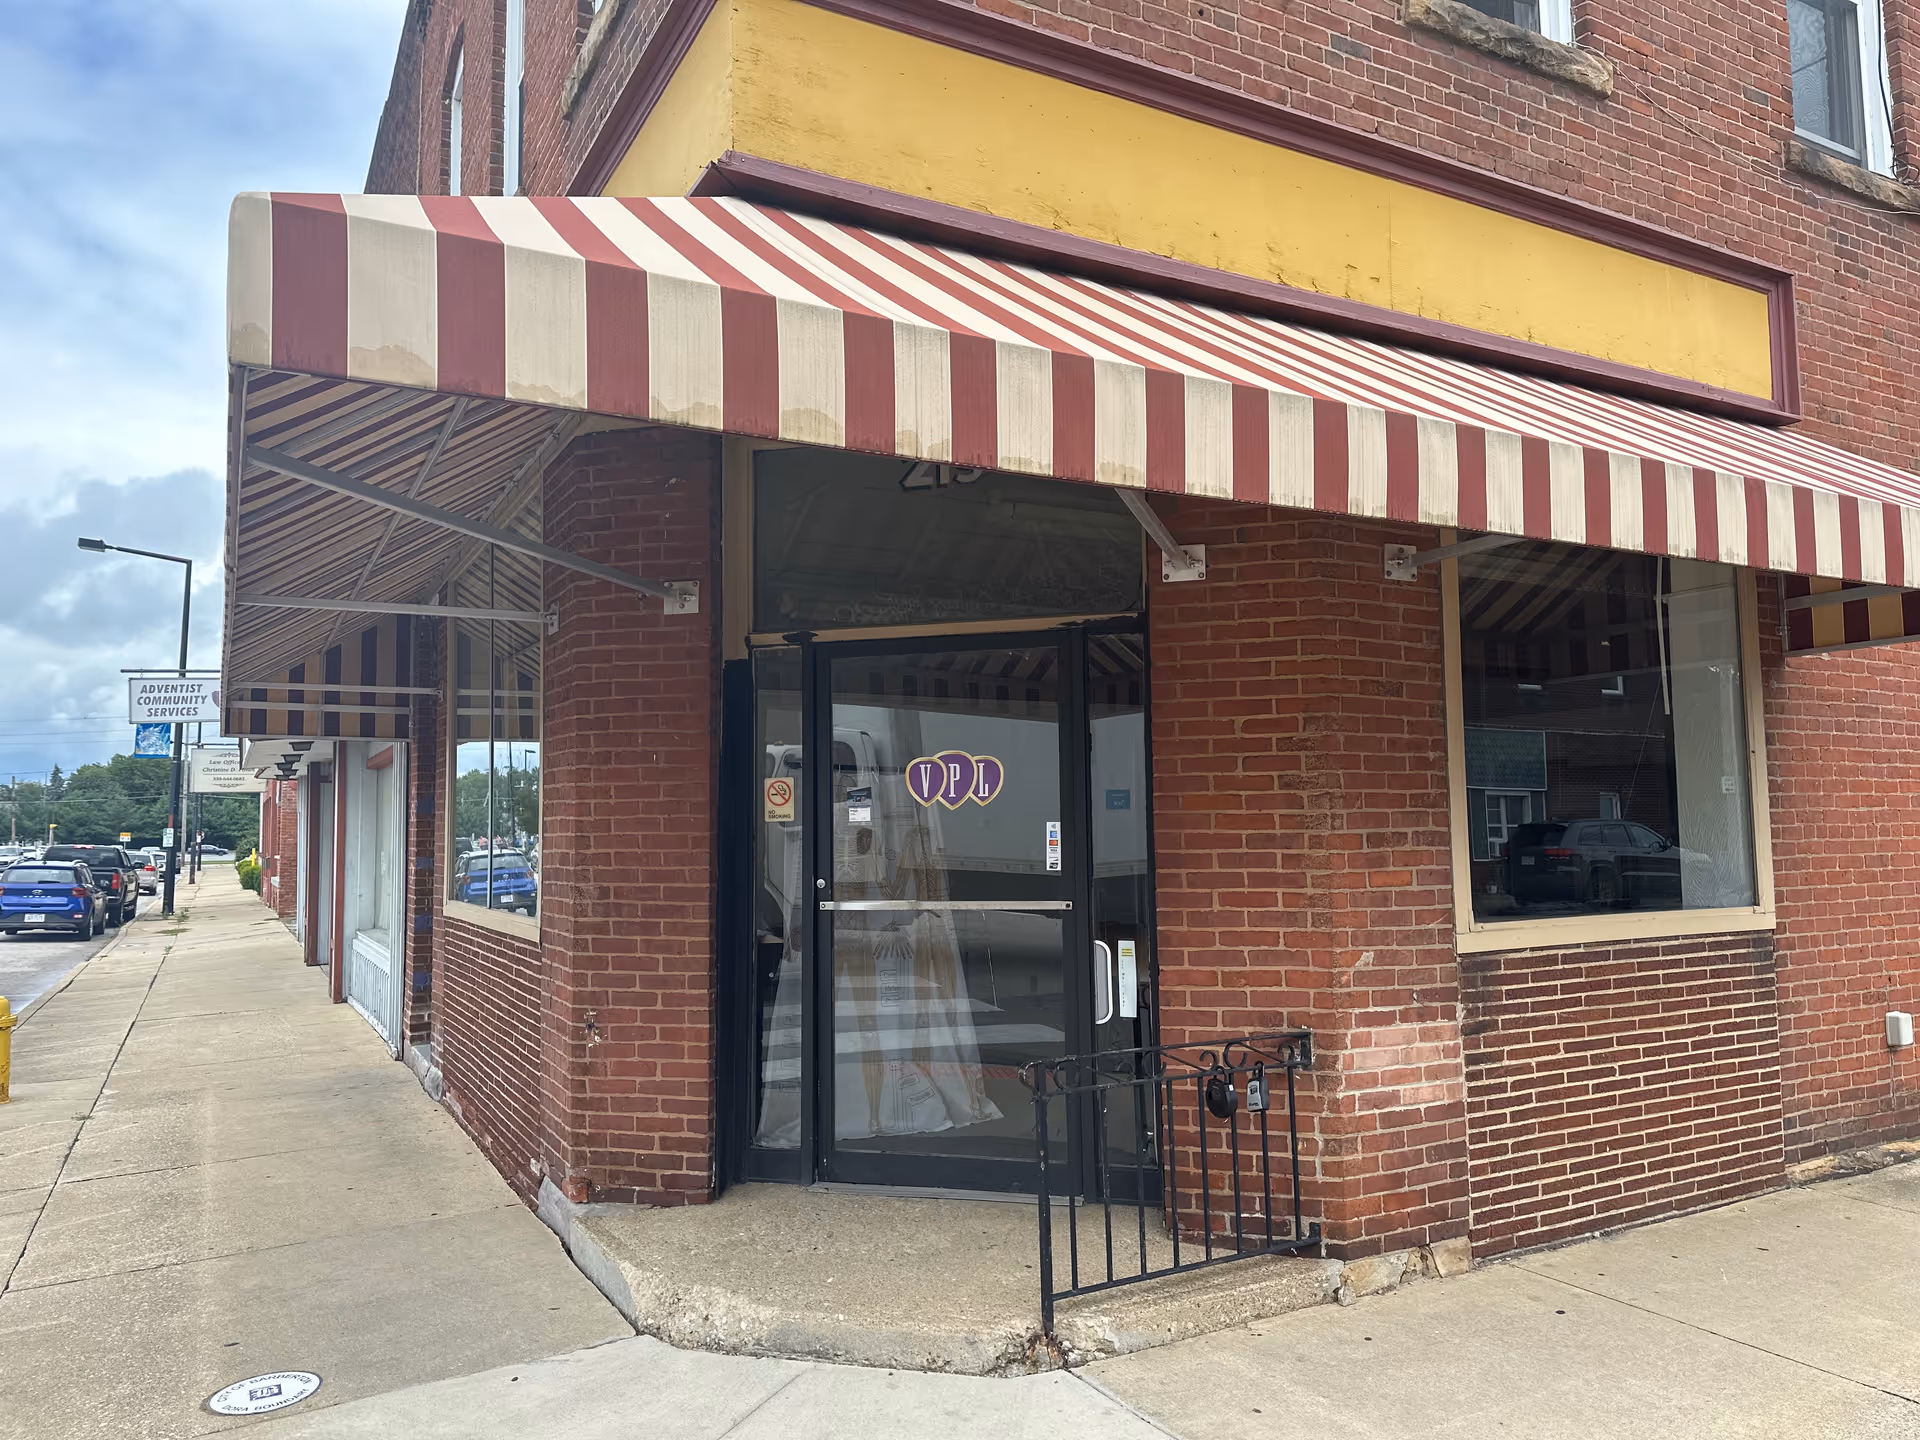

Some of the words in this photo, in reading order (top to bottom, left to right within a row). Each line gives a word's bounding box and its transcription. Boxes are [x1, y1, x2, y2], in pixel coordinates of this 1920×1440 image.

[140, 684, 203, 694] ADVENTIST
[137, 695, 208, 706] COMMUNITY
[147, 707, 199, 717] SERVICES
[217, 1391, 232, 1403] CITY
[249, 1374, 313, 1384] BARBERTON
